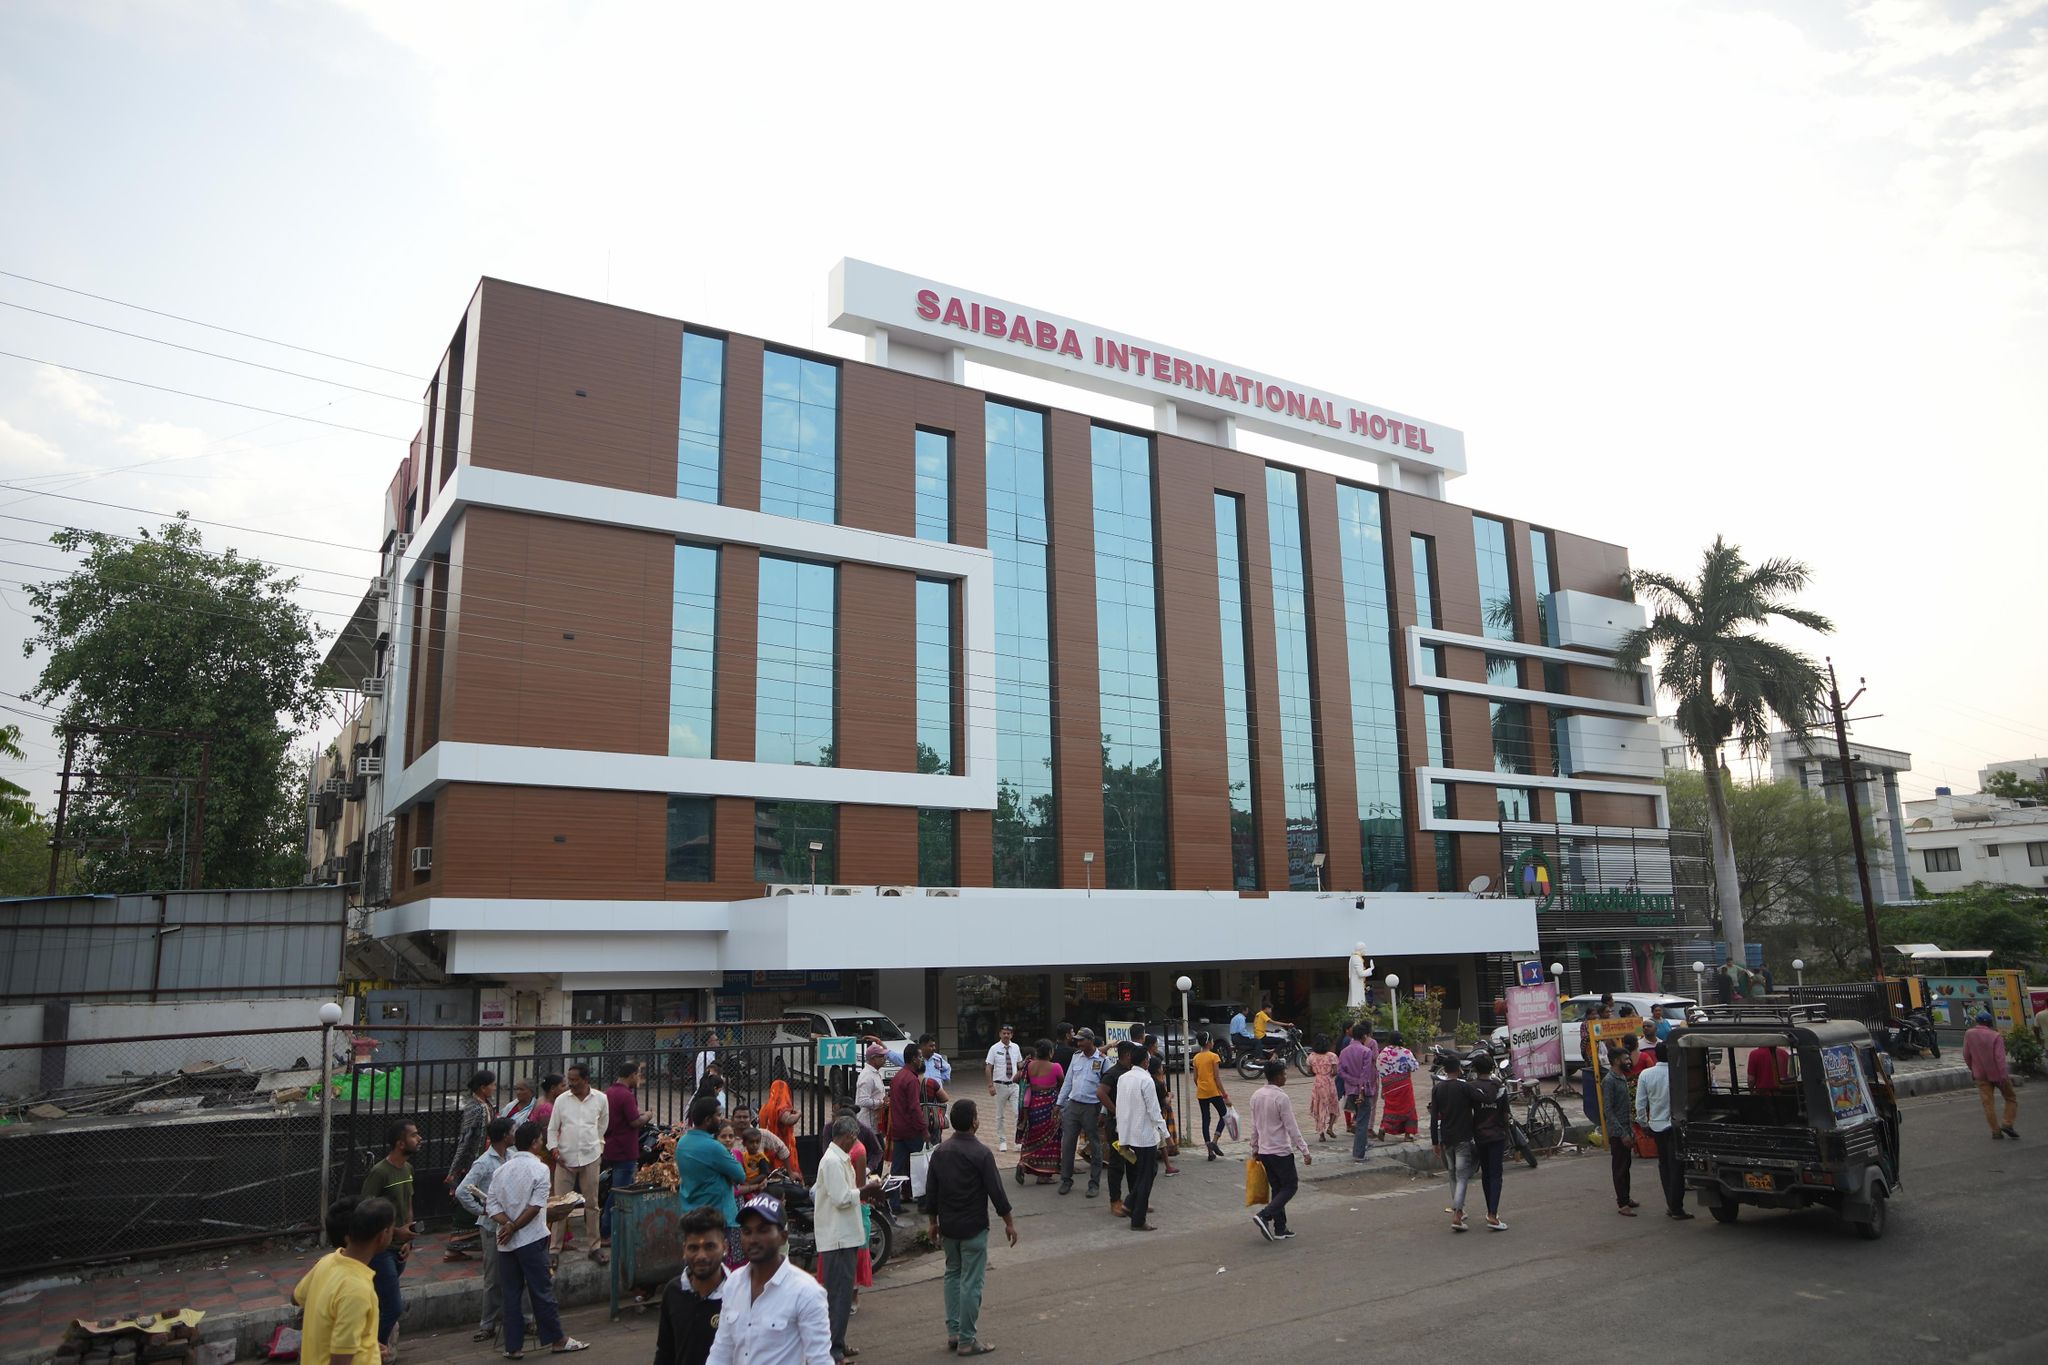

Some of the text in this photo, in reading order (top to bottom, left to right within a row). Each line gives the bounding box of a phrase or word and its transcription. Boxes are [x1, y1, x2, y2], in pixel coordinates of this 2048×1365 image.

[917, 290, 1433, 454] SAIBABA INTERNATIONAL HOTEL
[1107, 1028, 1131, 1041] PARKI
[1512, 1024, 1558, 1048] Special Offer
[826, 1043, 849, 1060] IN
[745, 1196, 779, 1212] WAG
